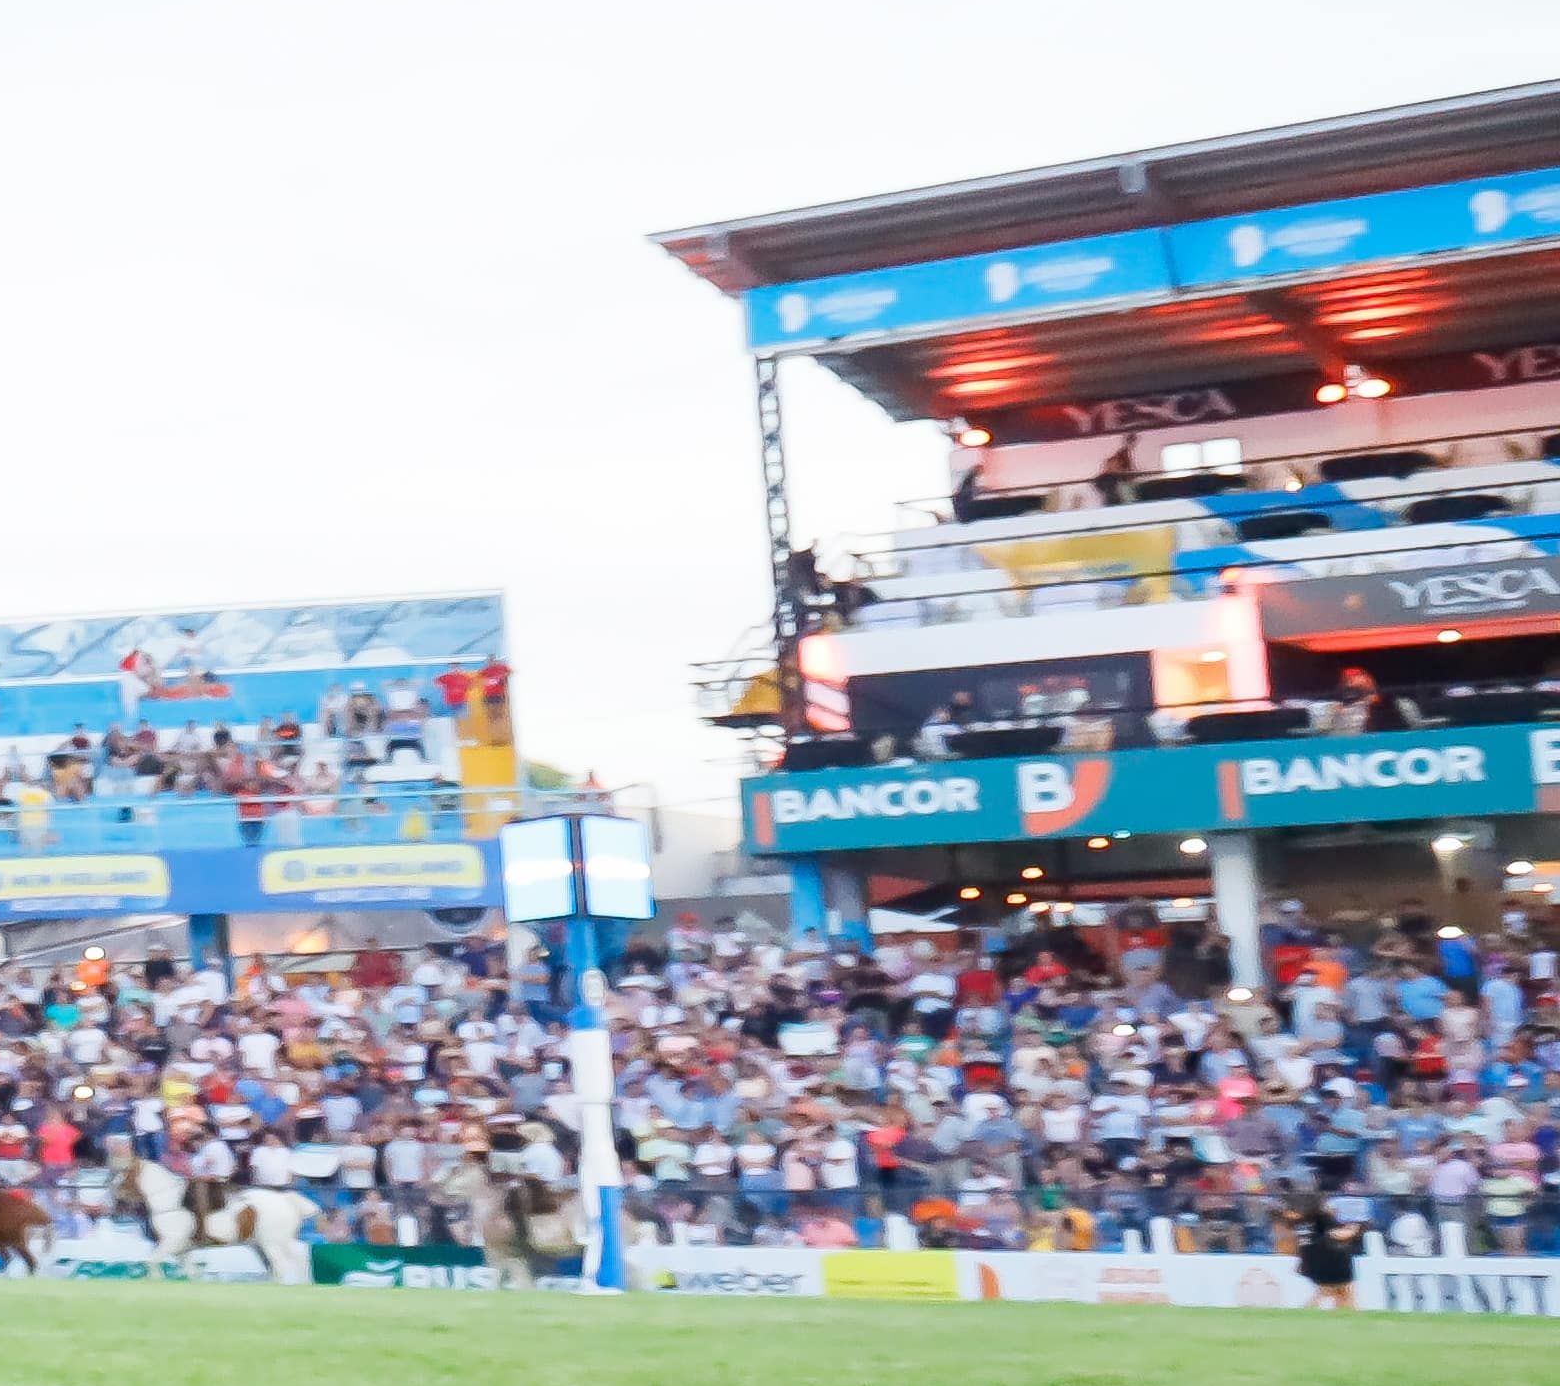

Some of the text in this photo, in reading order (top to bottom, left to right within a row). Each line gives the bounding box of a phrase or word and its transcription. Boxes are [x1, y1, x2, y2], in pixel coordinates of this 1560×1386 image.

[1064, 388, 1236, 434] YESCA
[1386, 567, 1560, 609] YESCA
[1241, 745, 1486, 795] BANCOR
[773, 777, 980, 824] BANCOR
